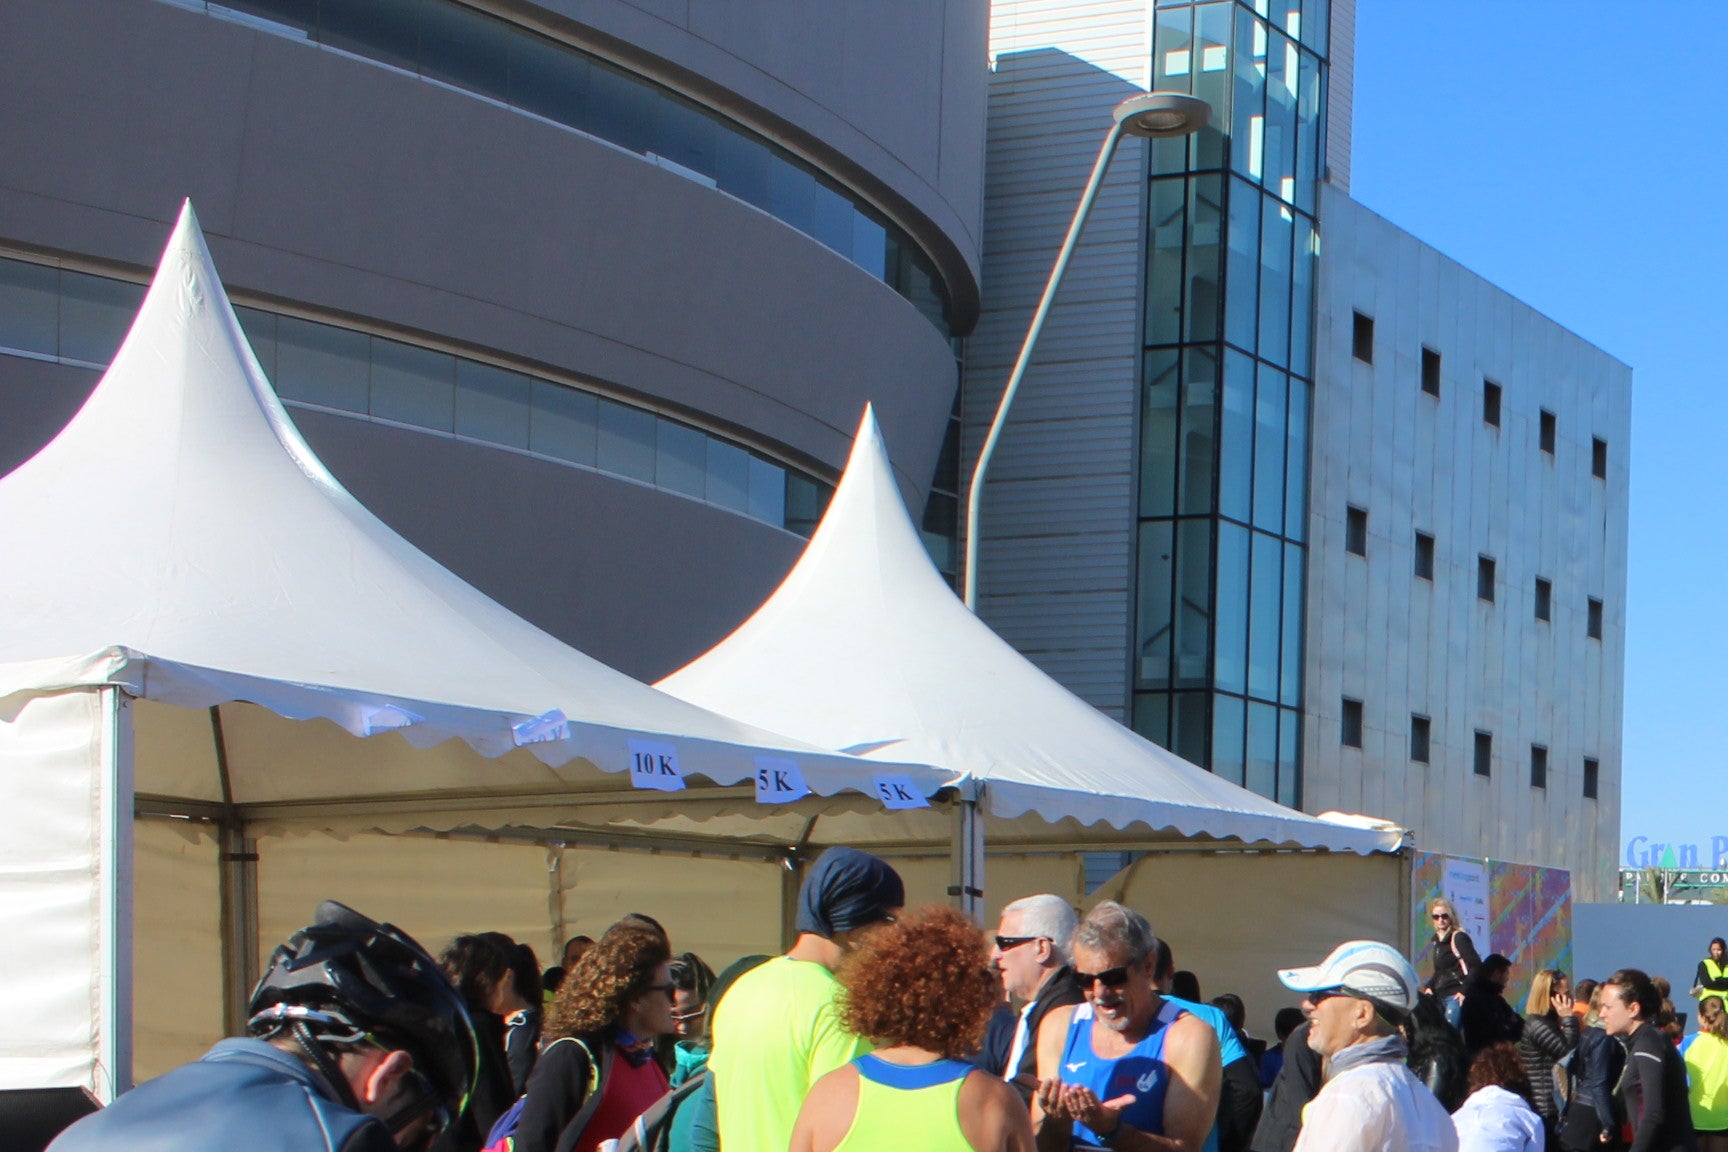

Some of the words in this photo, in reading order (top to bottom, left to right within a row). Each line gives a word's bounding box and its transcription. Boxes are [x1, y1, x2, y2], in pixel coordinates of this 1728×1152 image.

[634, 752, 653, 774] 10
[660, 755, 677, 776] K
[759, 769, 769, 791] 5
[775, 771, 794, 792] K
[881, 783, 892, 801] 5
[896, 784, 913, 801] K
